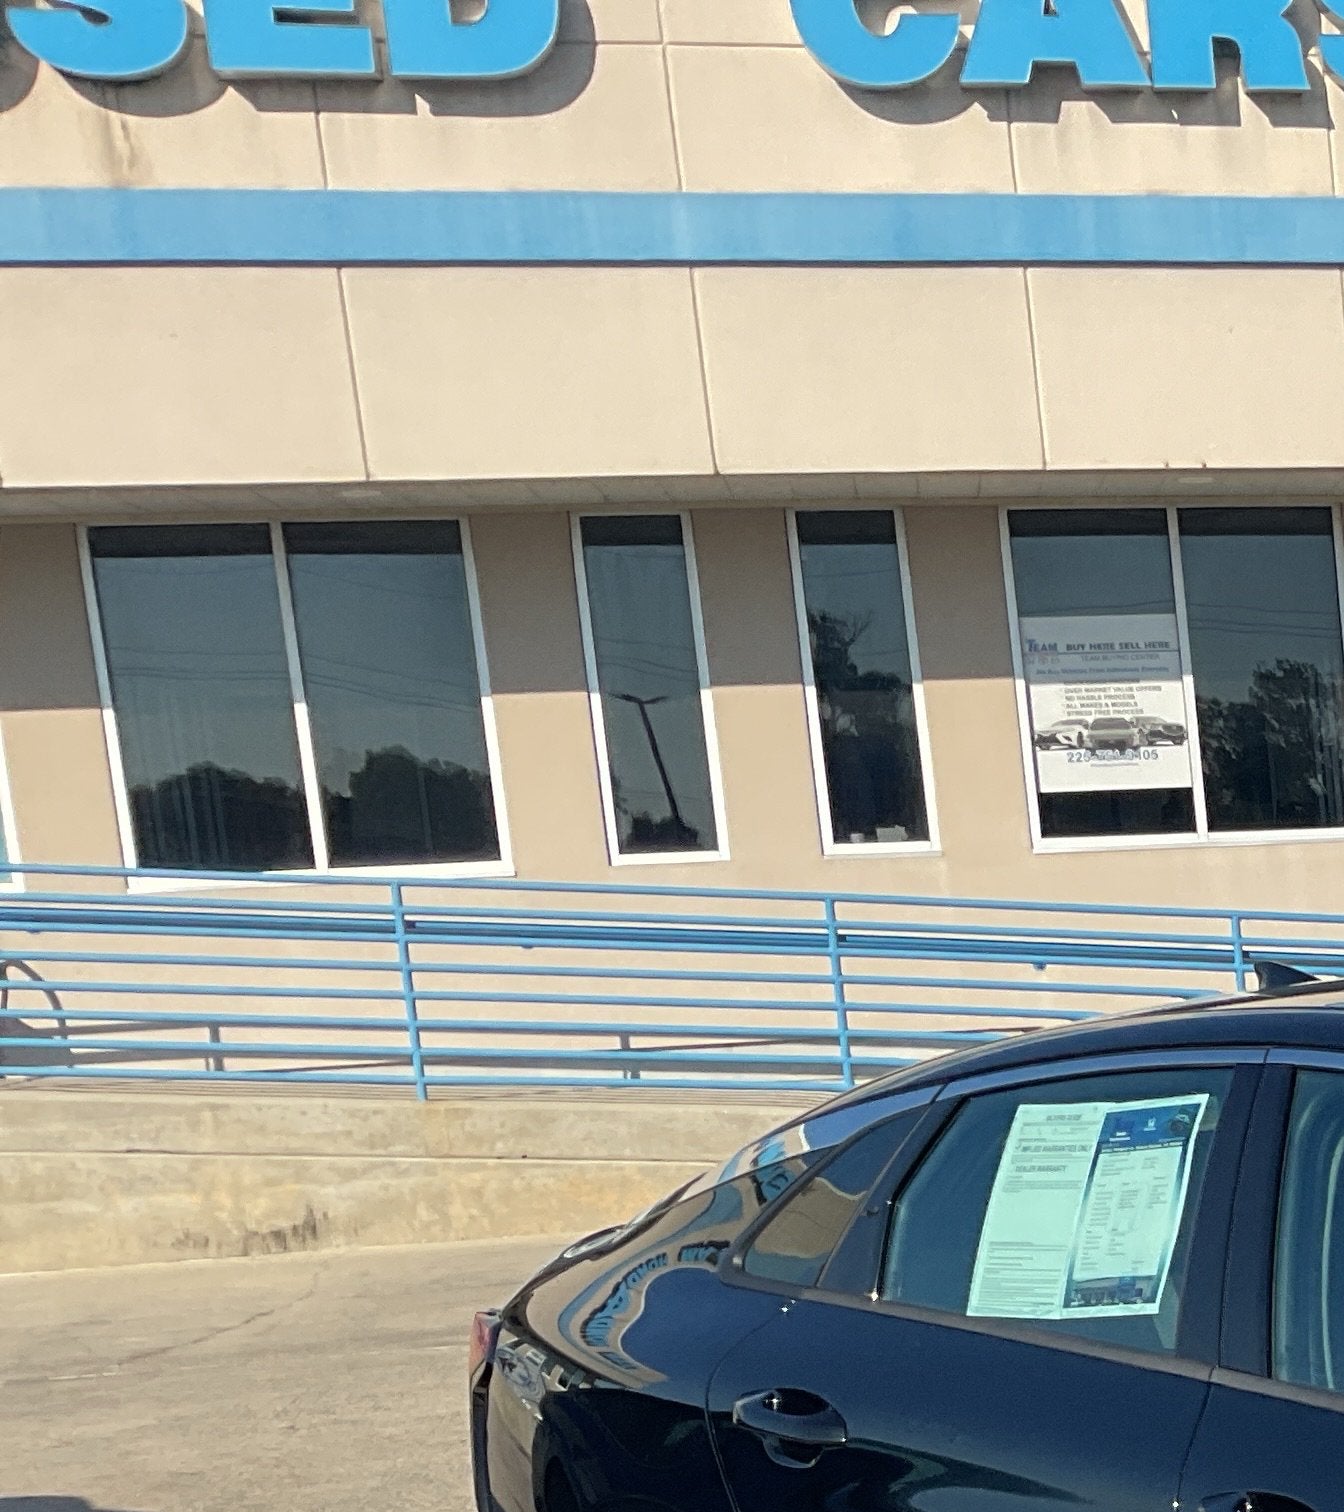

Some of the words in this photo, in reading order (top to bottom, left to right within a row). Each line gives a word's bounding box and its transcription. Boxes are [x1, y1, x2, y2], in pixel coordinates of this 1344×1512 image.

[1066, 643, 1086, 652] BUY
[1089, 642, 1116, 651] HERE
[1118, 641, 1141, 650] SELL
[1144, 640, 1171, 649] HERE
